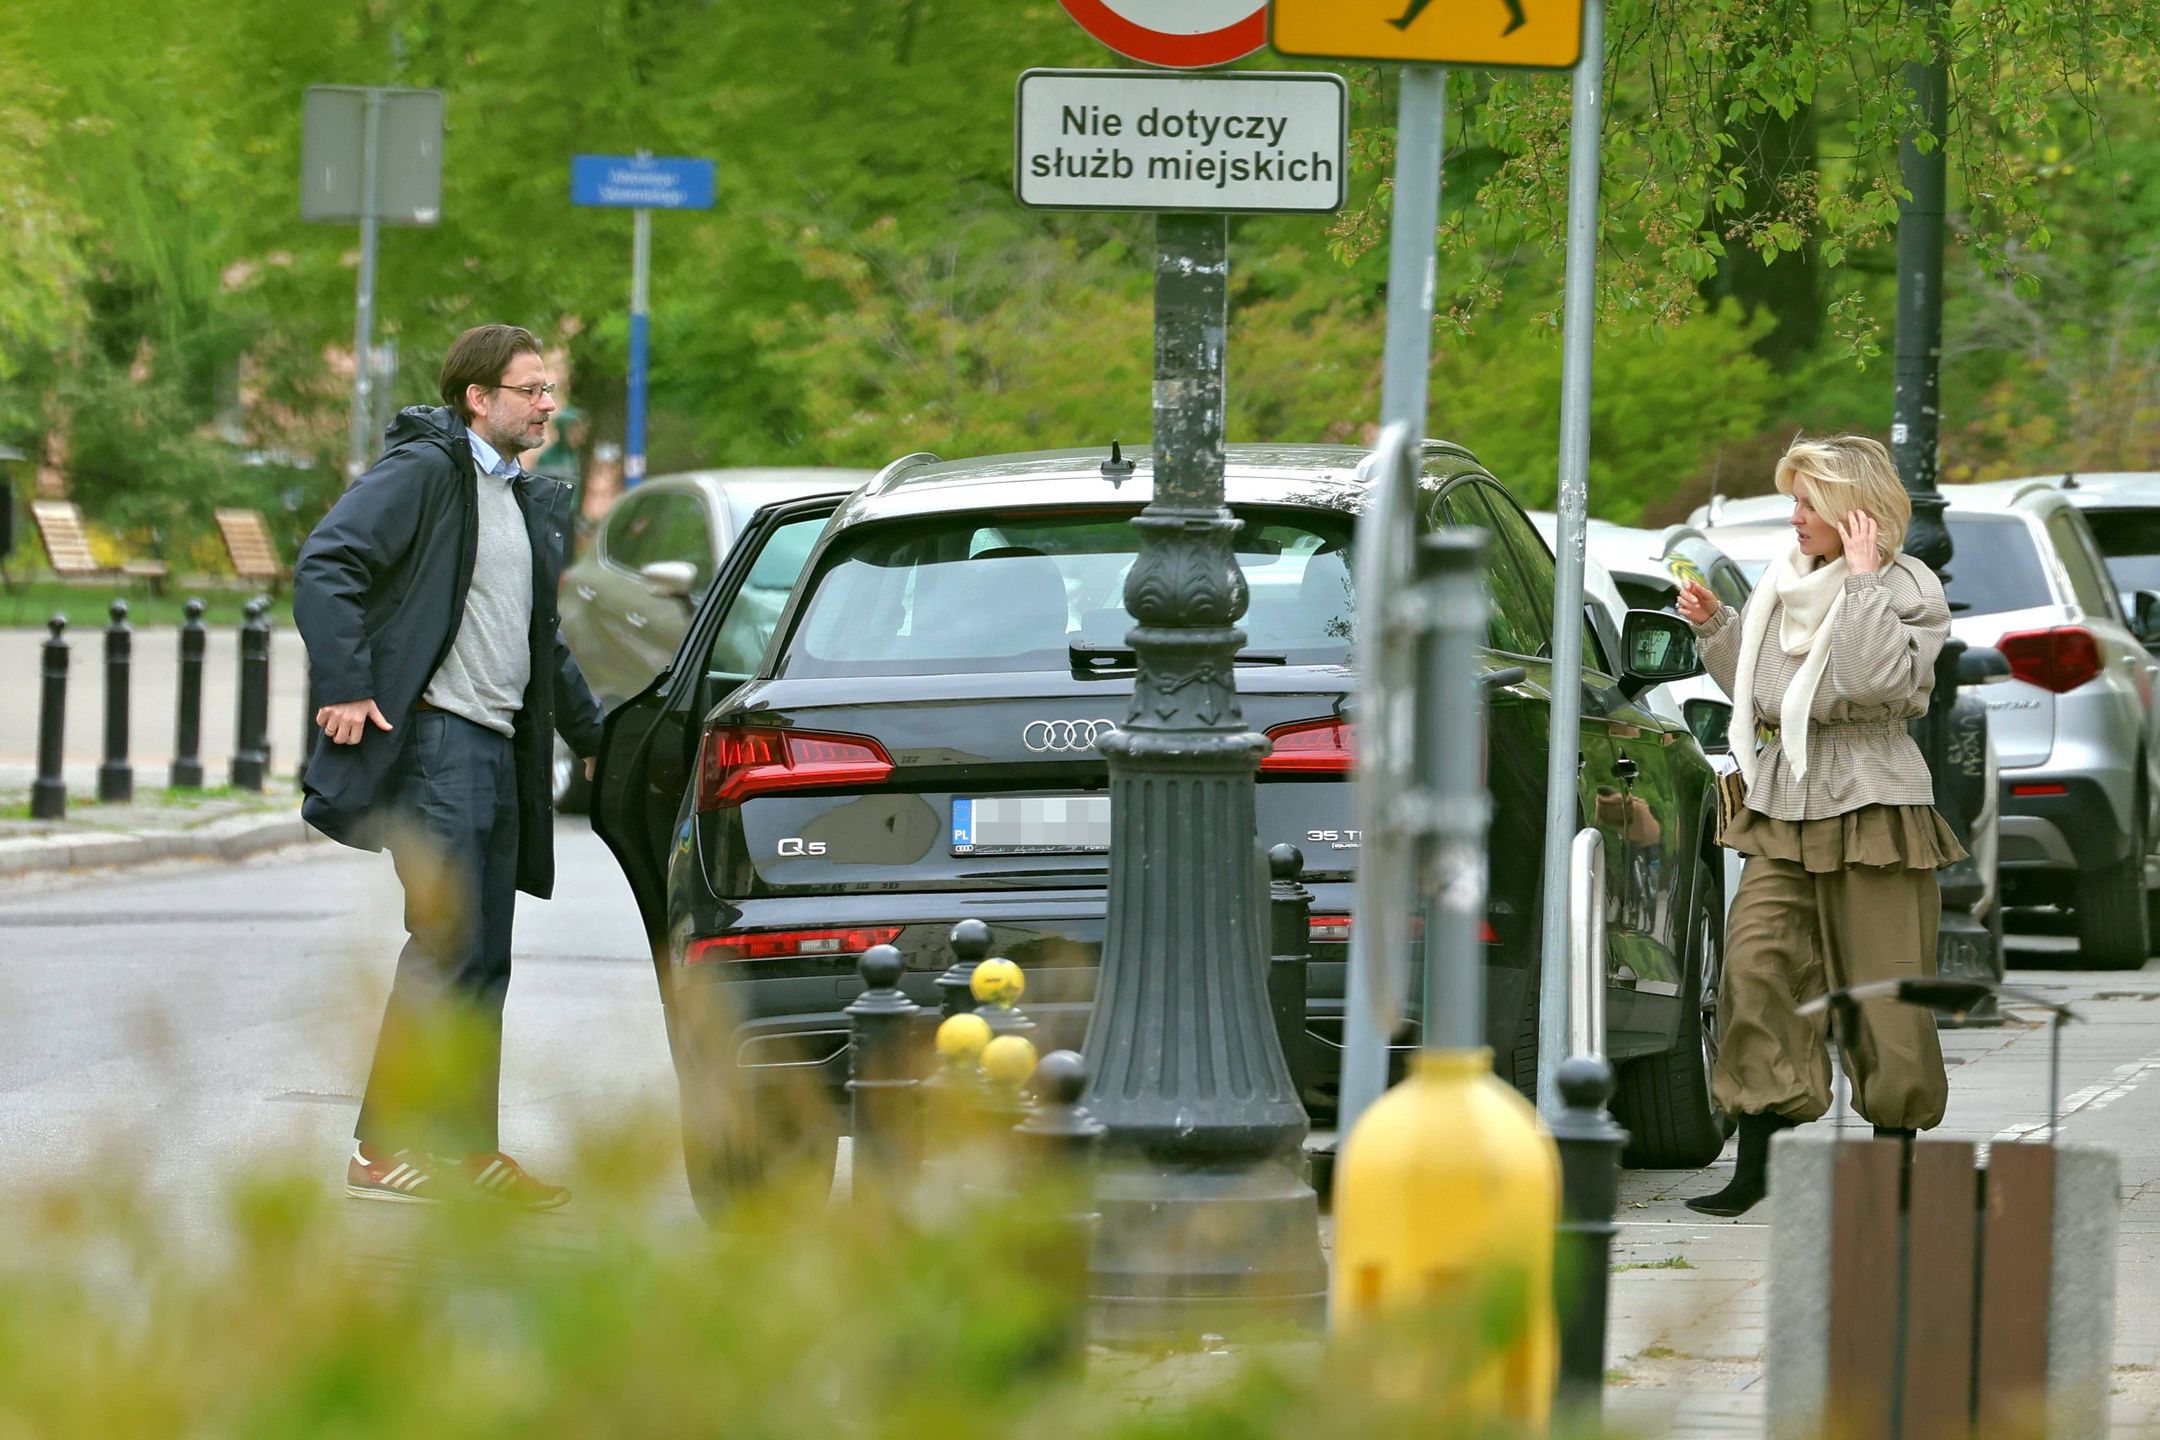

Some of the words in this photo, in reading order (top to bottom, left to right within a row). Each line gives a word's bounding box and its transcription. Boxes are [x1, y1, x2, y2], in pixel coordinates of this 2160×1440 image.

[1061, 105, 1122, 136] Nie
[1136, 107, 1288, 147] dotyczy
[1030, 147, 1134, 178] służb
[1147, 150, 1333, 189] miejskich
[955, 829, 969, 840] PL
[1307, 830, 1339, 841] 35
[777, 837, 827, 857] Q5
